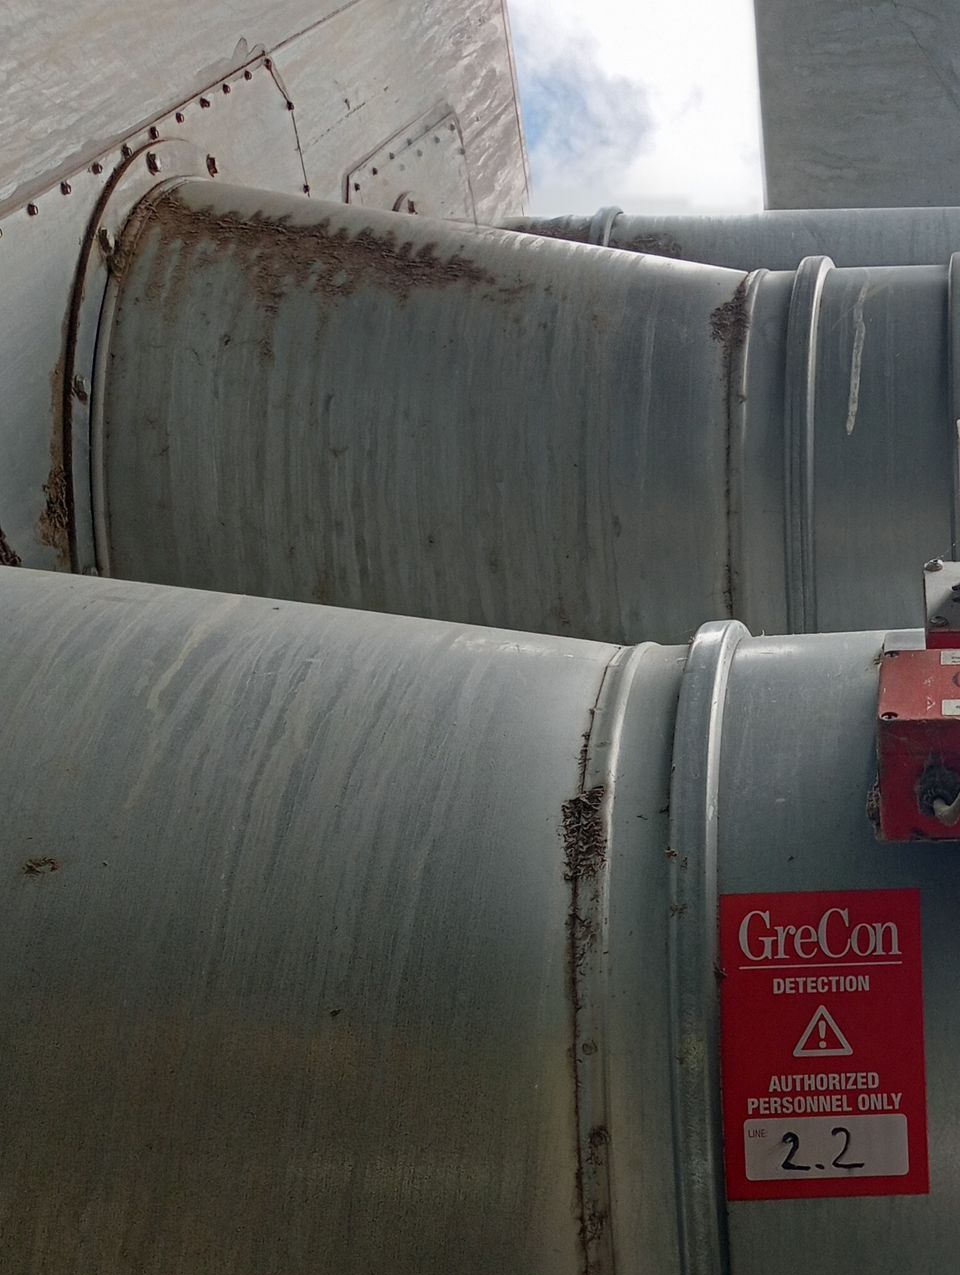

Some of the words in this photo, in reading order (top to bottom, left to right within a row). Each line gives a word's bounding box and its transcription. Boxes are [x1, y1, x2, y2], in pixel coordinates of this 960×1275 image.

[738, 907, 902, 961] GreCon
[772, 975, 870, 995] DETECTION
[768, 1072, 880, 1093] AUTHORIZED
[747, 1095, 853, 1115] PERSONNEL
[857, 1093, 903, 1112] ONLY
[781, 1126, 865, 1172] 2.2
